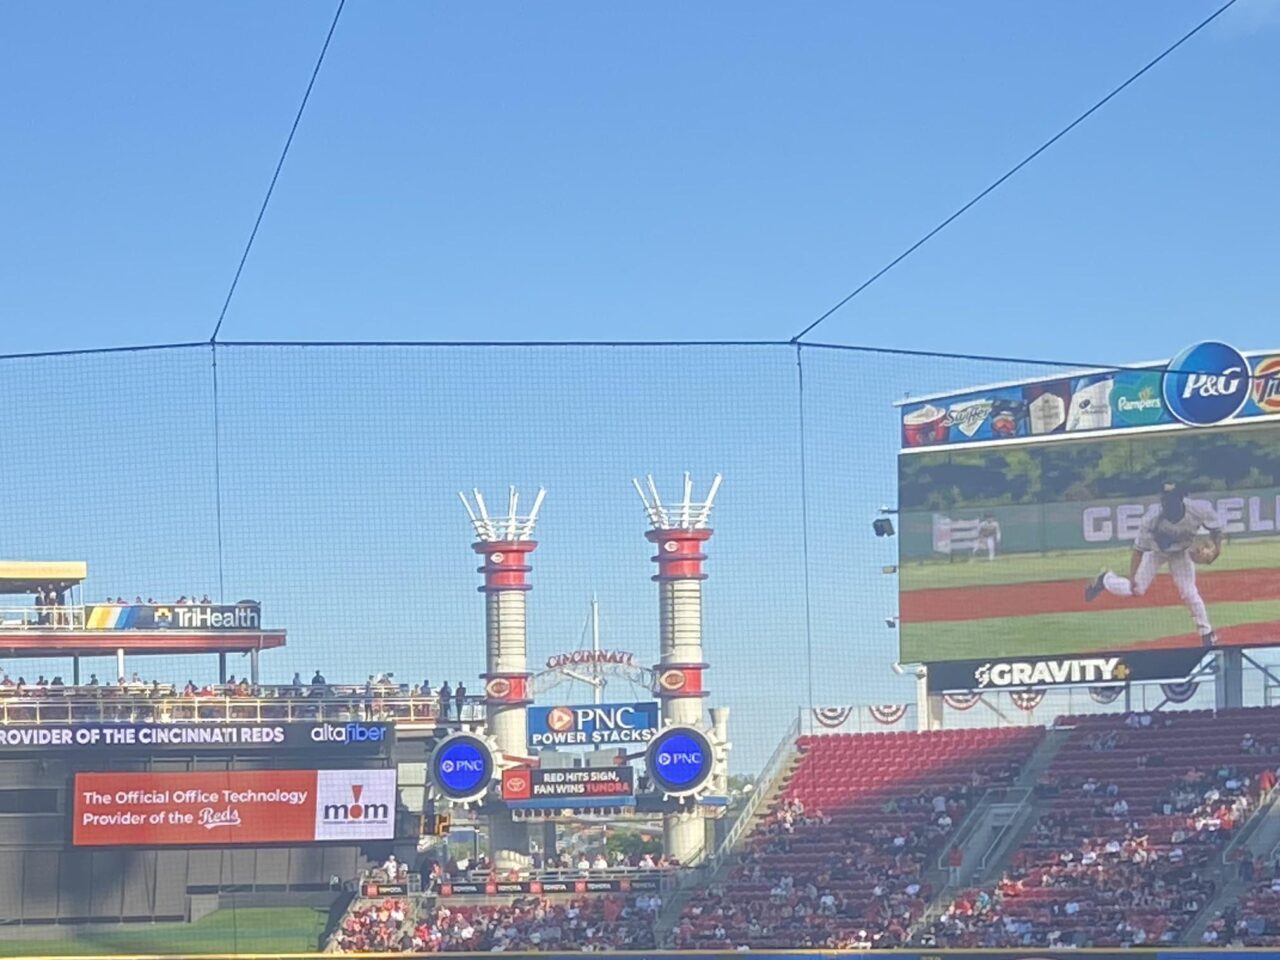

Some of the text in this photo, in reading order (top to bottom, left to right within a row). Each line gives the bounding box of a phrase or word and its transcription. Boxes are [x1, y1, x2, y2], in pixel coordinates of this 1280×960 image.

[1182, 367, 1241, 398] P&G
[1118, 397, 1162, 412] Pampers
[941, 405, 992, 427] Swiffer
[174, 607, 258, 628] TriHealth
[545, 649, 635, 669] CINCINNATI
[575, 706, 635, 731] PNC
[76, 728, 100, 744] OF
[102, 728, 136, 744] THE
[138, 727, 238, 744] CINCINNATI
[240, 726, 285, 743] REDS
[310, 723, 387, 744] altafiber
[532, 727, 652, 745] POWER STACKS
[455, 759, 484, 772] PNC
[672, 753, 702, 765] PNC
[543, 770, 620, 783] RED HITS SIGN,
[83, 788, 308, 806] The Official Office Technology
[533, 781, 630, 795] FAN WINS TUNDRA
[82, 806, 242, 830] Provider of the Reds
